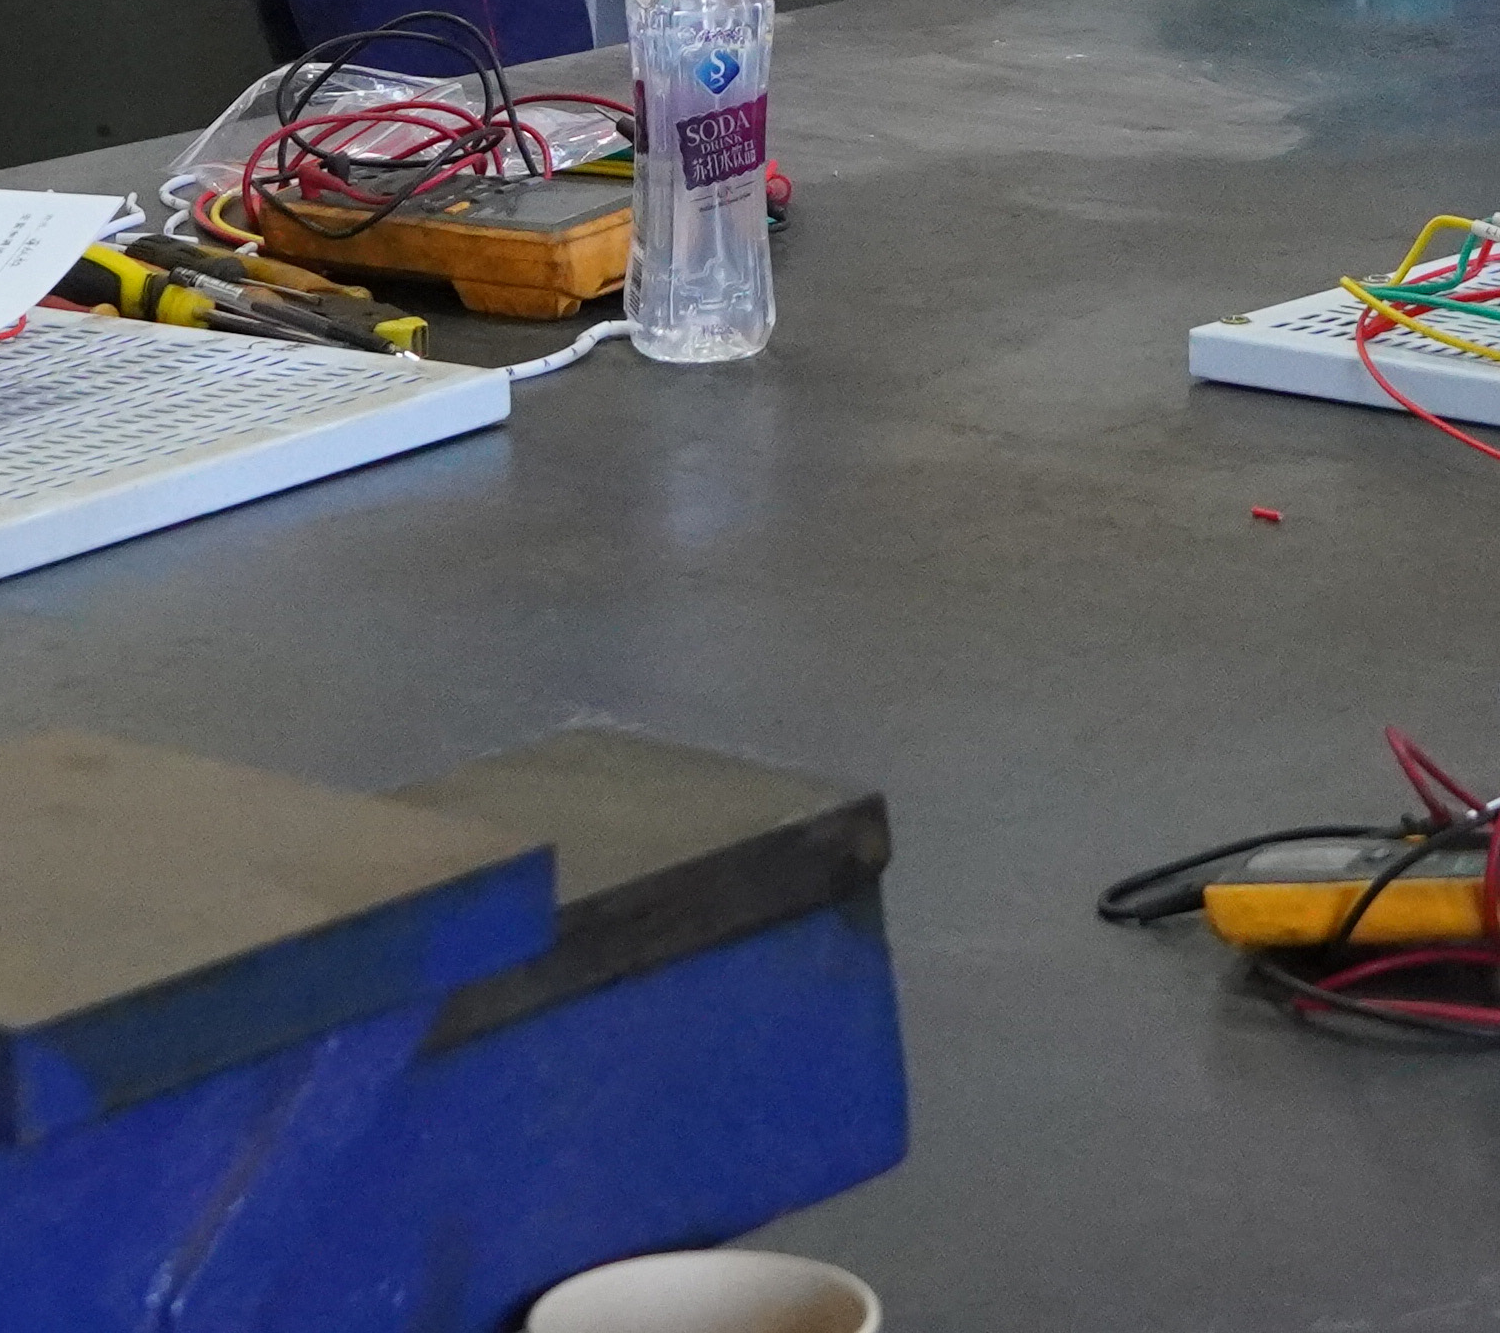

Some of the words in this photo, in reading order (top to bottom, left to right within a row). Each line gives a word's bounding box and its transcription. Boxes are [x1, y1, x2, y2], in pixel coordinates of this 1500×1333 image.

[686, 110, 751, 147] SODA
[701, 134, 743, 155] DRINK
[692, 140, 757, 183] 苏打水饮品
